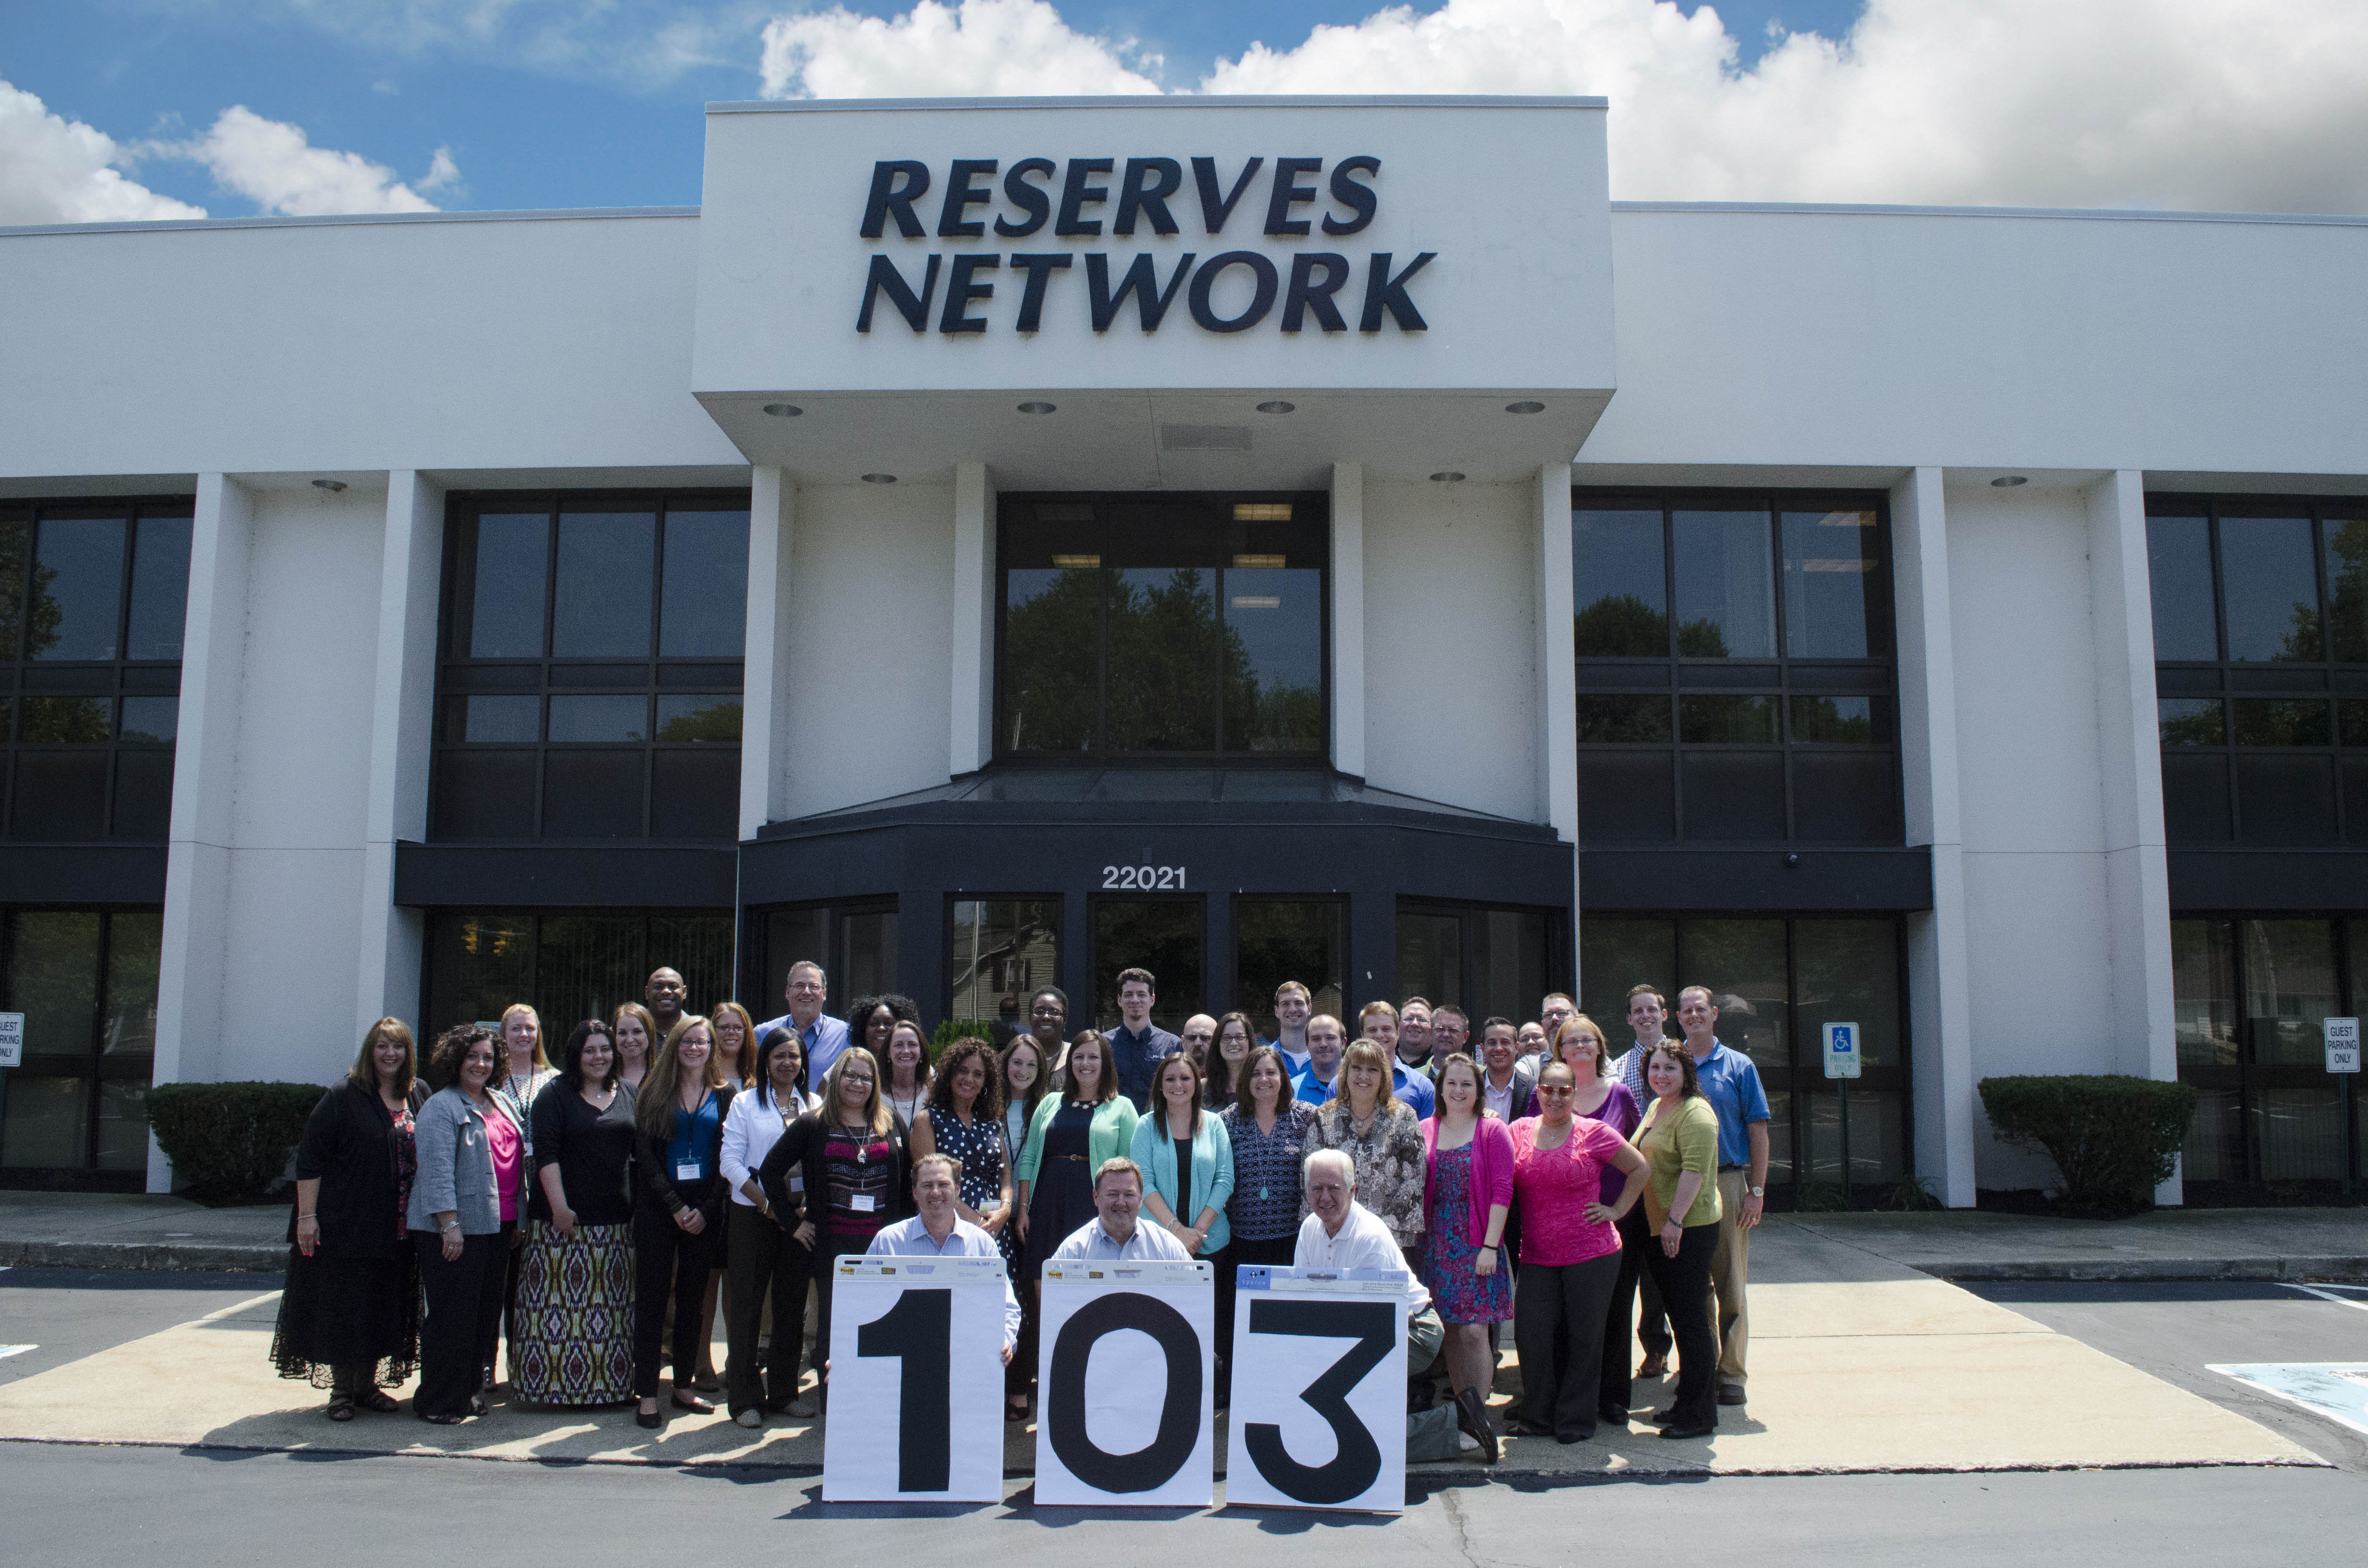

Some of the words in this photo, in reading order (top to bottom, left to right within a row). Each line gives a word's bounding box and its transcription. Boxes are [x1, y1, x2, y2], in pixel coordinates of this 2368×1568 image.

[859, 156, 1381, 238] RESERVES
[857, 250, 1438, 334] NETWORK
[1102, 866, 1185, 889] 22021
[0, 1021, 18, 1031] UEST
[2331, 1027, 2353, 1036] GUEST
[0, 1034, 19, 1044] RKING
[2328, 1040, 2356, 1050] PARKING
[1830, 1054, 1856, 1063] PARKING
[2334, 1054, 2351, 1063] ONLY
[857, 1288, 952, 1492] 1
[1048, 1292, 1203, 1494] 0
[1245, 1298, 1396, 1505] 3
